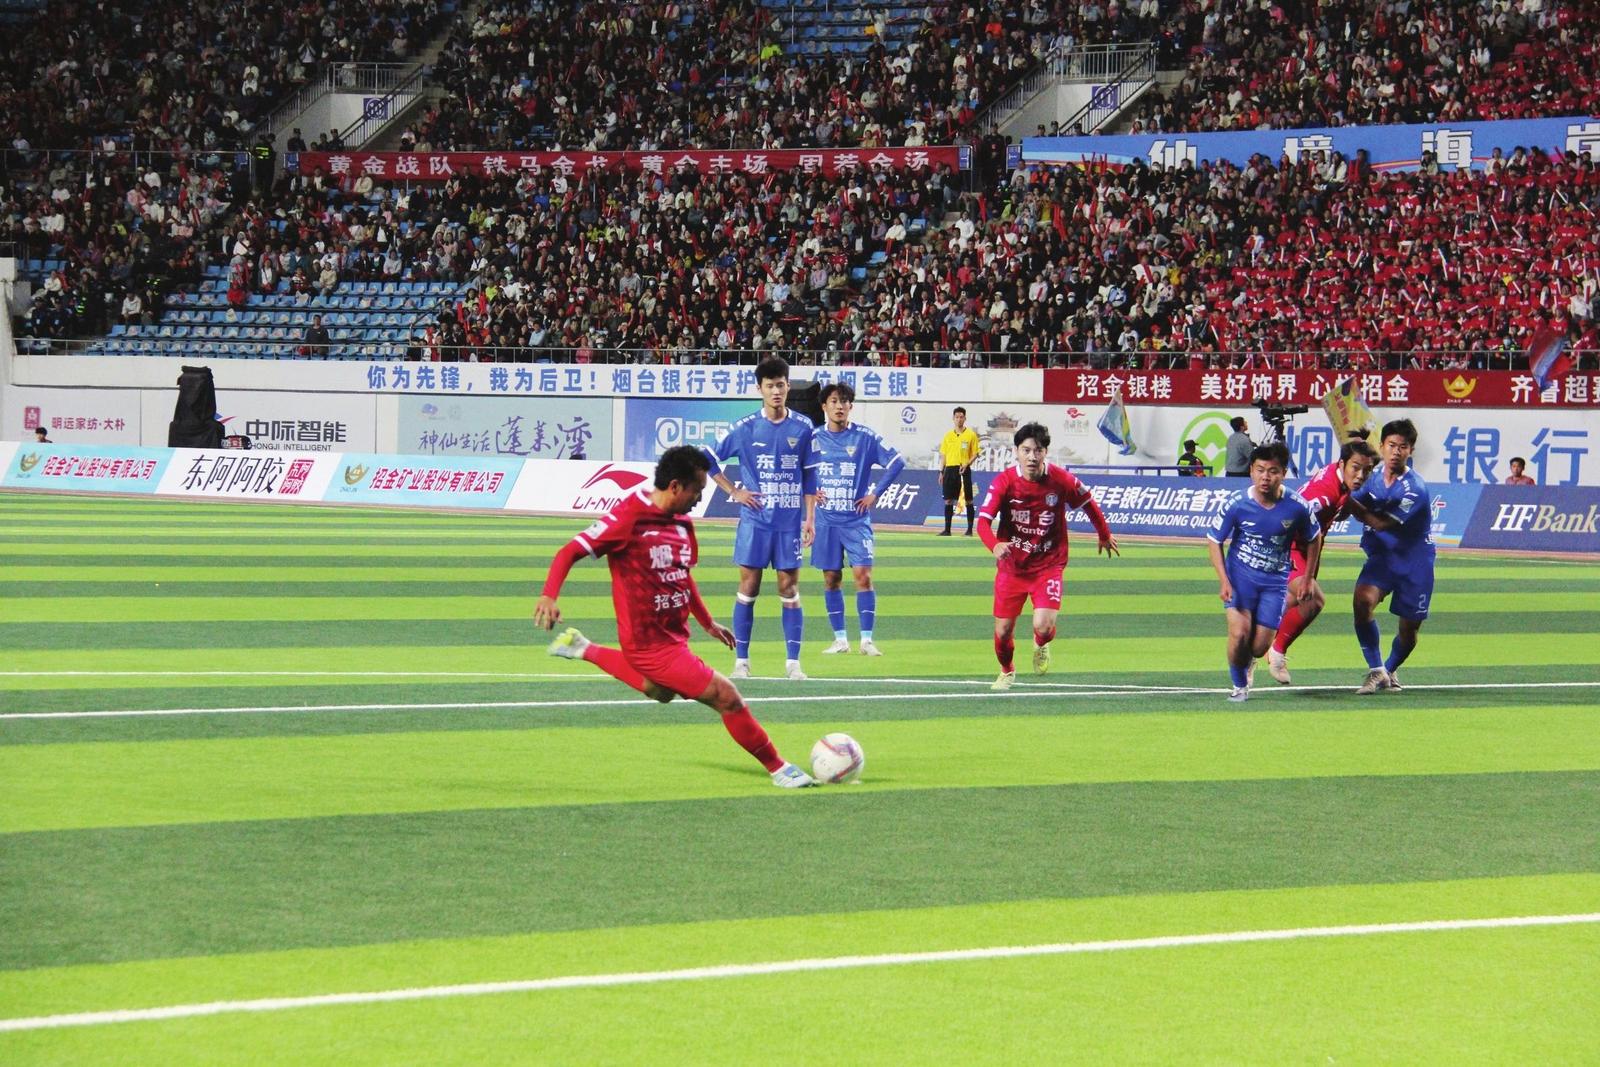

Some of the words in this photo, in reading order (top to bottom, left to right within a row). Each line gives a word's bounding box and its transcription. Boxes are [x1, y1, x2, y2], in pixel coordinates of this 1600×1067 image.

[328, 155, 453, 176] 黄金战队
[1076, 373, 1173, 399] 招金银楼
[1200, 373, 1297, 400] 美好饰界
[245, 418, 347, 443] 中际智能
[283, 443, 332, 452] INTELLIGENT
[41, 456, 157, 480] 招金矿业股份有限公司
[179, 454, 286, 495] 东阿阿胶
[759, 471, 794, 481] Dongying
[369, 467, 505, 494] 招金矿业股份有限公司
[1010, 509, 1055, 526] 烟台
[1130, 512, 1188, 527] SHANDONG
[1491, 503, 1600, 533] HFBank
[1046, 579, 1061, 597] 23
[1418, 594, 1428, 611] 2
